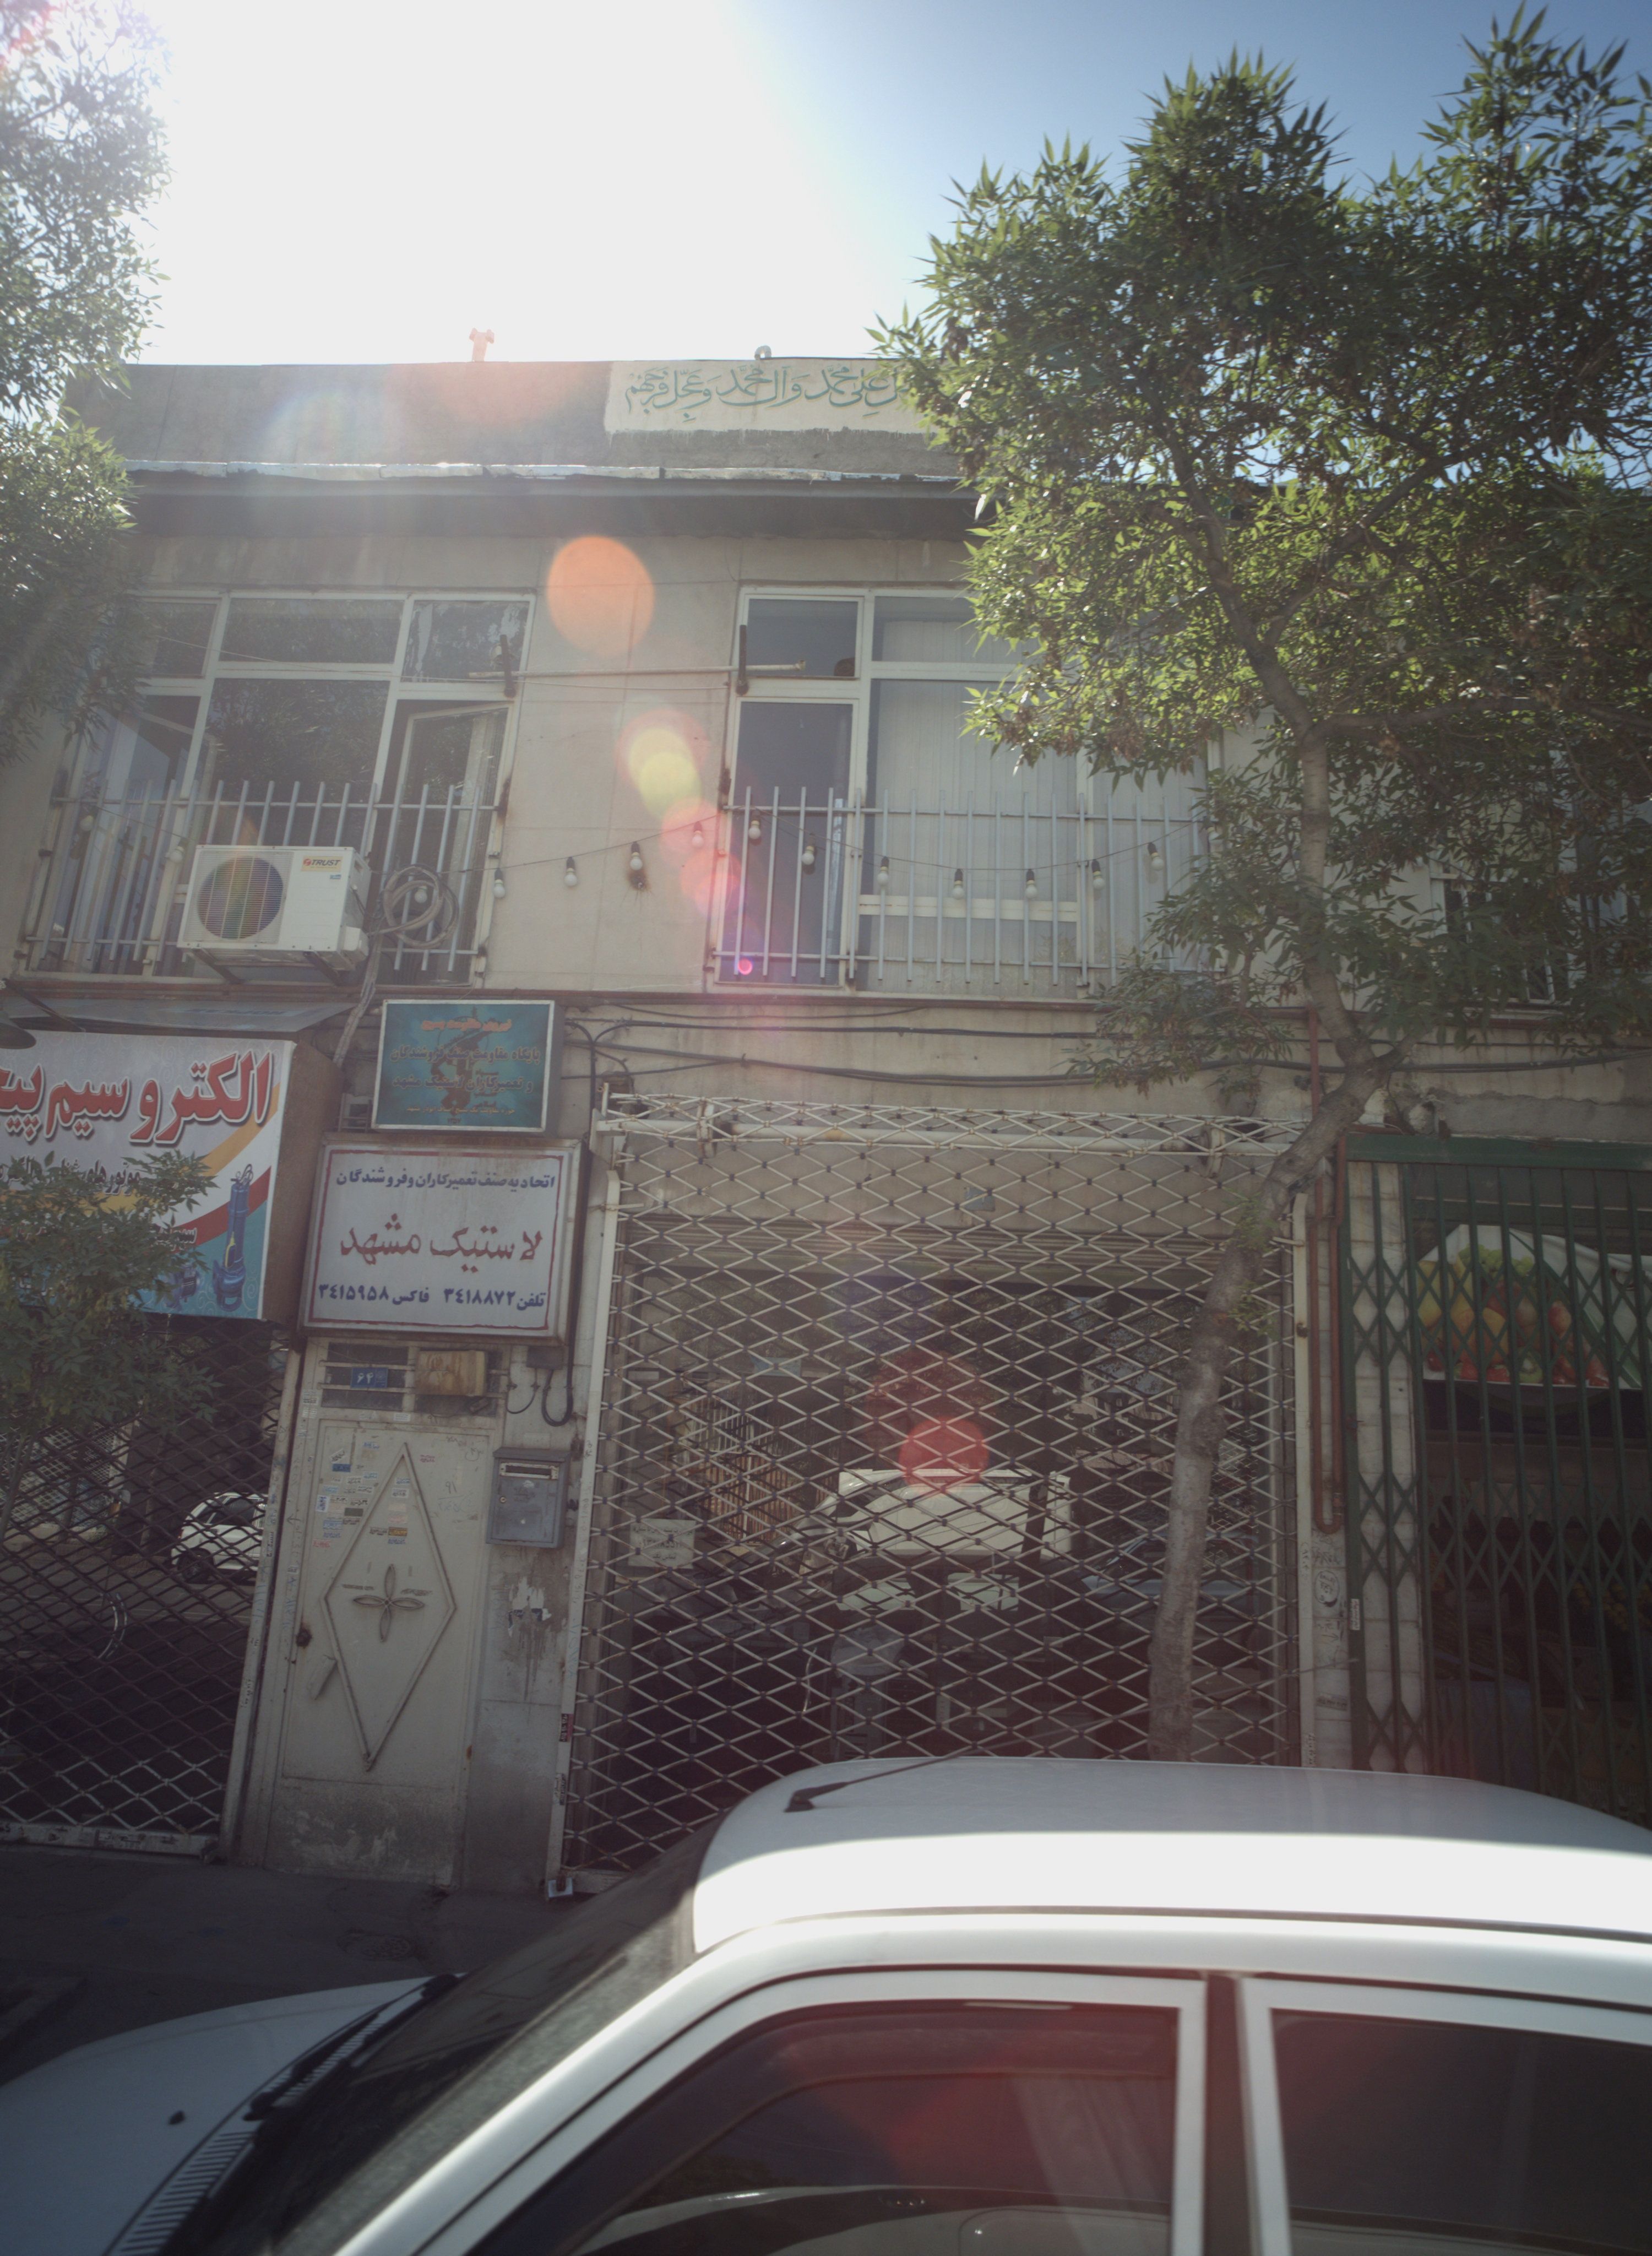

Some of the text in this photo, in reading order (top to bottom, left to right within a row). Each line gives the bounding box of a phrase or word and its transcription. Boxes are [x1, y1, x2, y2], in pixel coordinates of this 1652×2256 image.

[625, 367, 669, 415] فرجهم
[389, 1044, 540, 1065] پایگاه مقاومت صنف فروشندگان
[392, 1074, 534, 1094] و تعمیرکاران لاستیک مشهد
[45, 1077, 130, 1138] سیم
[415, 1171, 477, 1190] تعمیرکاران
[477, 1171, 507, 1187] صنف
[508, 1175, 555, 1192] اتحادیه
[340, 1213, 543, 1273] لاستیک مشهد
[392, 1287, 430, 1306] فاکس
[516, 1292, 547, 1311] تلفن
[357, 1372, 374, 1384] ۶۴
